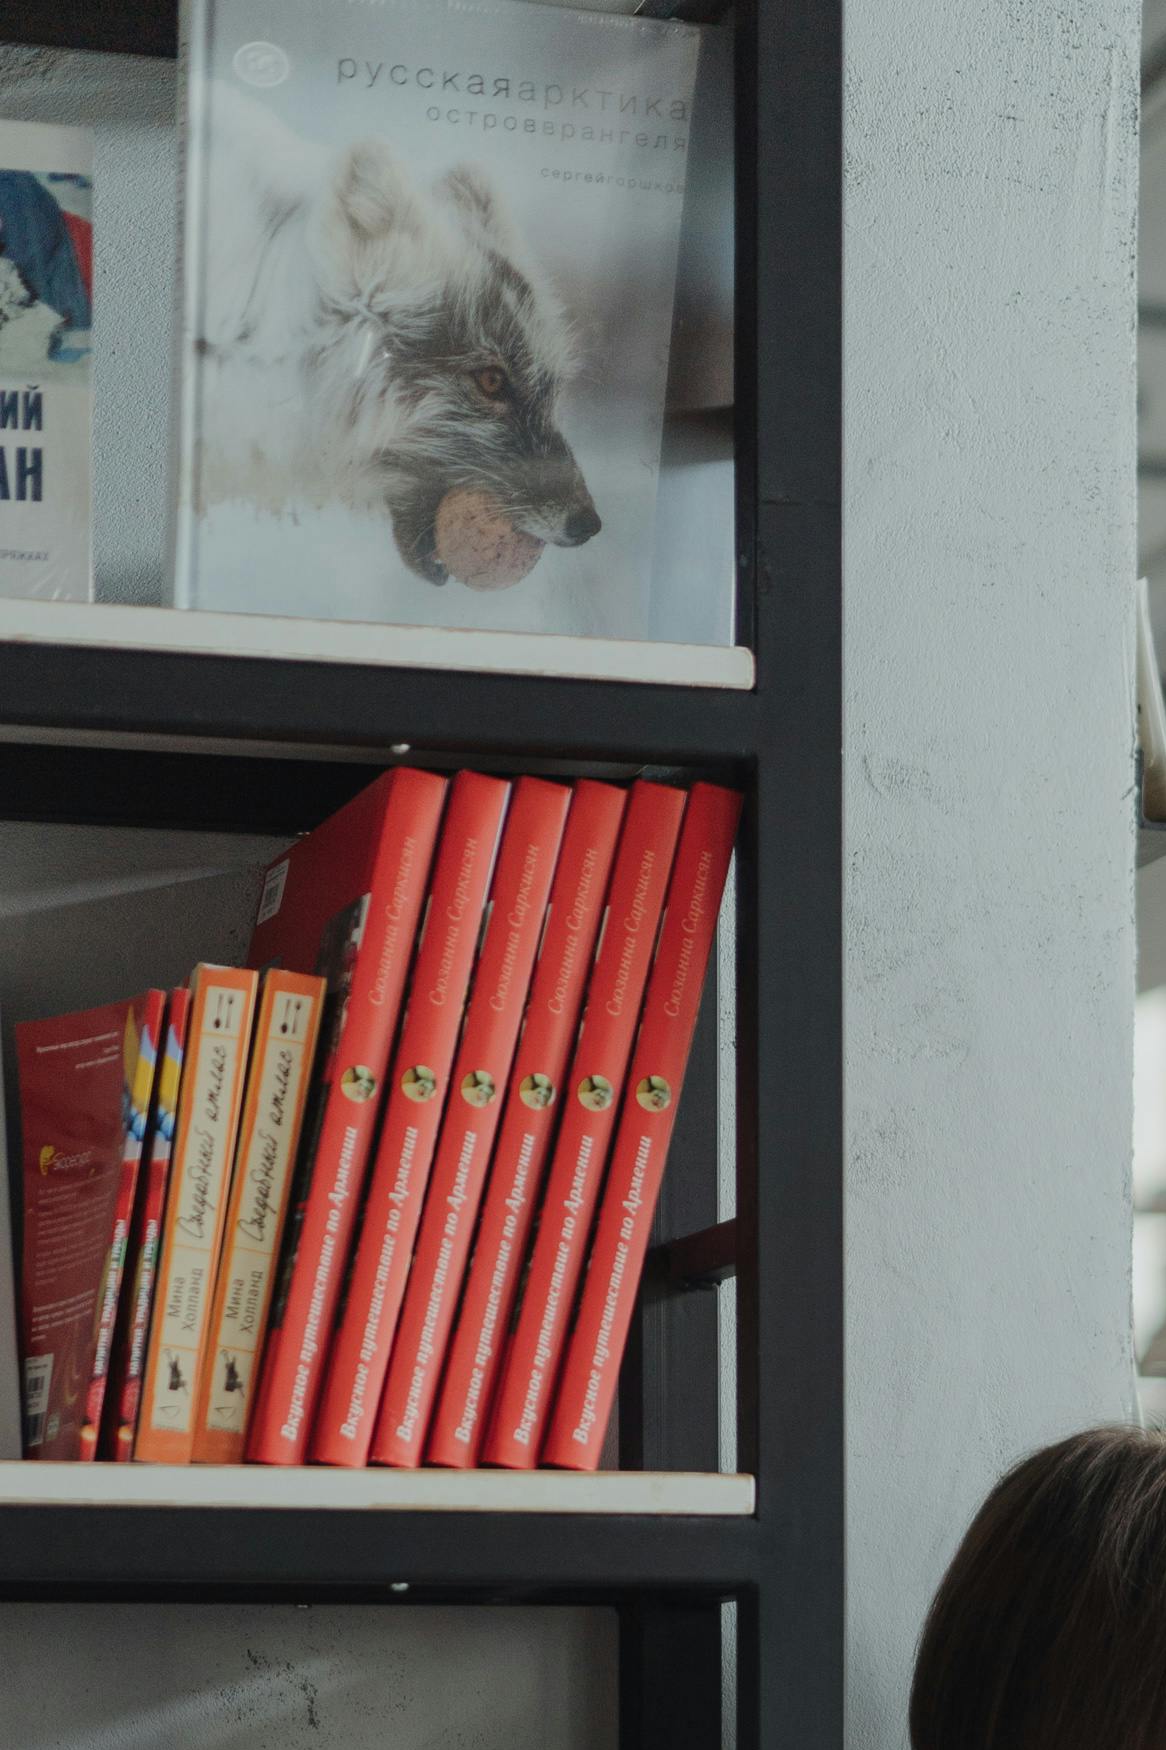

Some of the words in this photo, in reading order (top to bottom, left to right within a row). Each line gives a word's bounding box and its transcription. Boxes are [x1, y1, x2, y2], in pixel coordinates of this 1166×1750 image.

[337, 57, 687, 122] русскаяарктика
[426, 106, 687, 152] островврангеля
[369, 925, 399, 1005] Сюзанна
[386, 837, 416, 921] Саркисян
[429, 926, 459, 1005] Сюзанна
[448, 838, 477, 921] Саркисян
[489, 932, 520, 1011] Сюзанна
[508, 844, 540, 927] Саркисян
[548, 934, 579, 1014] Сюзанна
[567, 848, 598, 931] Саркисян
[606, 936, 636, 1016] Сюзанна
[624, 850, 656, 932] Саркисян
[664, 937, 694, 1017] Сюзанна
[682, 851, 713, 933] Саркисян
[176, 1129, 215, 1239] Съедобный
[205, 1044, 228, 1122] атлас
[238, 1131, 279, 1242] Съедобный
[267, 1049, 294, 1127] атлас
[328, 1127, 358, 1206] Армении
[389, 1128, 418, 1207] Армении
[447, 1131, 477, 1207] Армении
[505, 1134, 536, 1211] Армении
[564, 1135, 594, 1214] Армении
[623, 1136, 653, 1214] Армении
[326, 1209, 341, 1233] по
[386, 1208, 401, 1232] по
[443, 1212, 458, 1235] по
[503, 1214, 517, 1237] по
[561, 1216, 577, 1239] по
[620, 1216, 635, 1239] по
[167, 1276, 187, 1318] Мина
[182, 1267, 205, 1332] Холланд
[225, 1278, 245, 1320] Мина
[239, 1269, 264, 1335] Холланд
[299, 1235, 335, 1361] путешествие
[360, 1233, 395, 1360] путешествие
[416, 1238, 453, 1362] путешествие
[474, 1239, 512, 1364] путешествие
[535, 1242, 571, 1365] путешествие
[593, 1242, 629, 1365] путешествие
[281, 1364, 310, 1441] Вкусное
[340, 1364, 369, 1440] Вкусное
[396, 1366, 425, 1441] Вкусное
[455, 1368, 484, 1443] Вкусное
[514, 1370, 543, 1445] Вкусное
[573, 1370, 602, 1444] Вкусное
